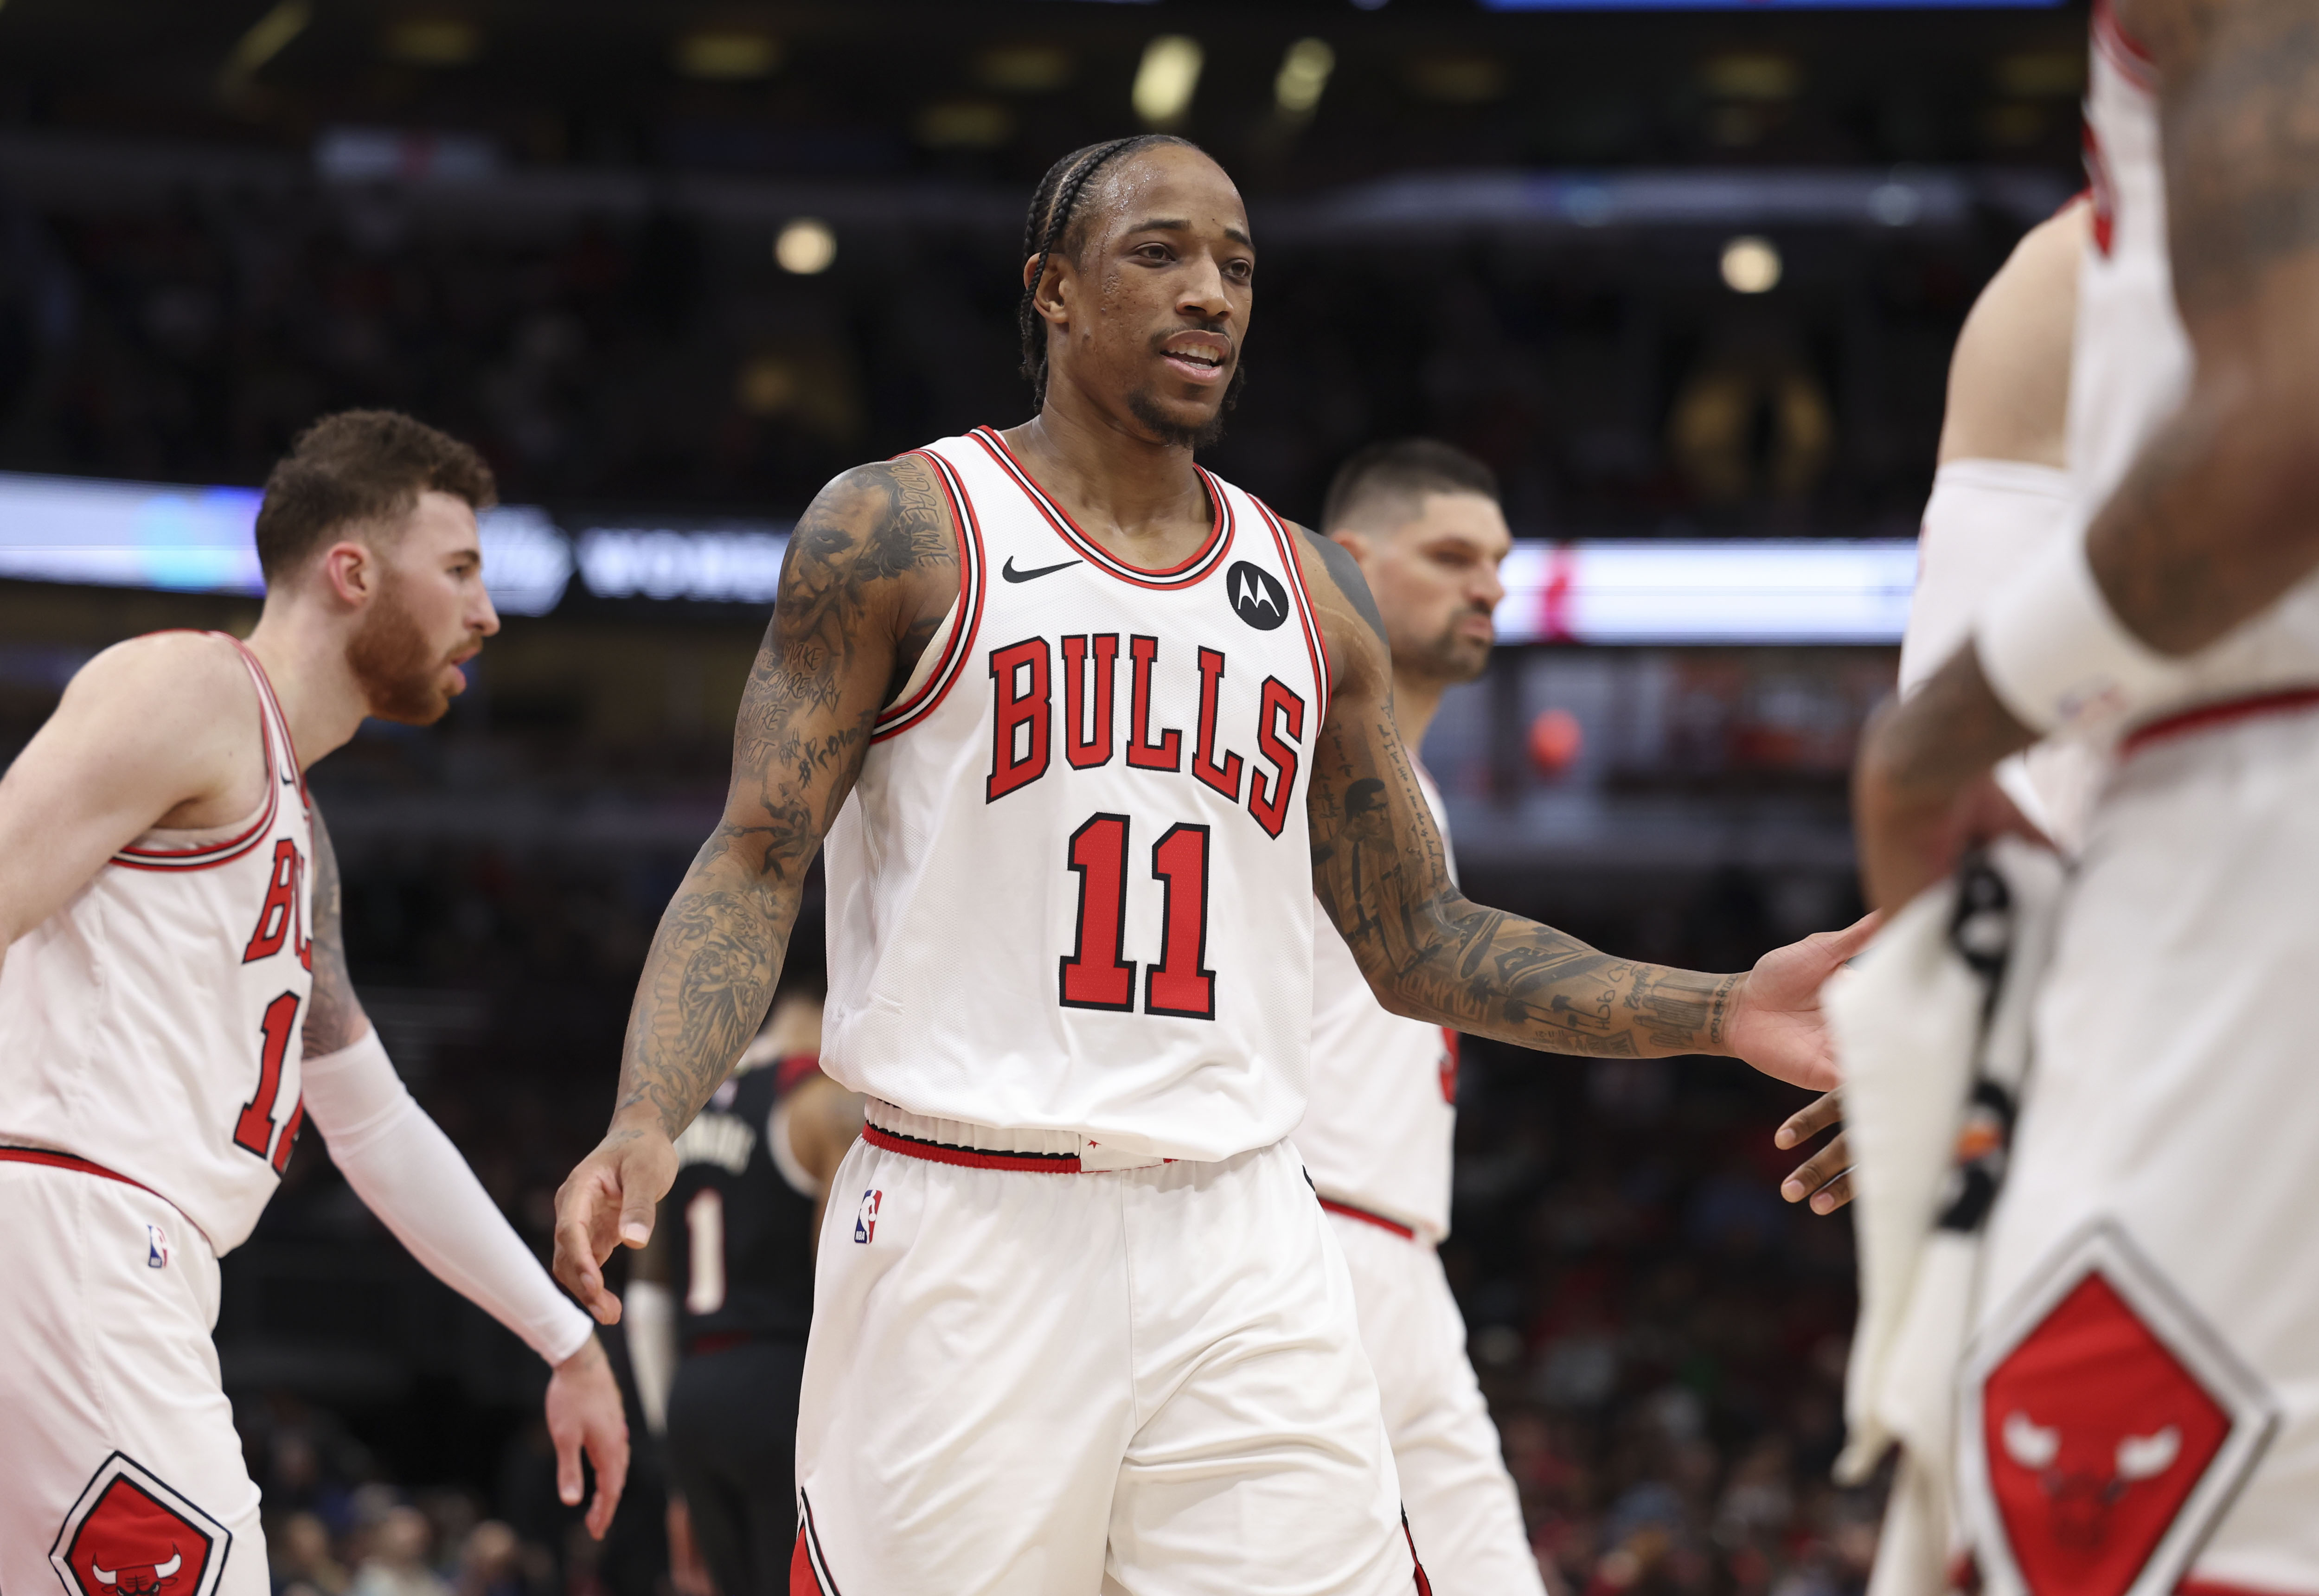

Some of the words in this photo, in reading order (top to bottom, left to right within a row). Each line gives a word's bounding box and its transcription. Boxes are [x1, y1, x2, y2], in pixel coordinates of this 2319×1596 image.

[987, 633, 1304, 840] BULLS
[1059, 812, 1216, 1020] 11
[684, 1185, 727, 1316] 1
[855, 1230, 865, 1241] NBA
